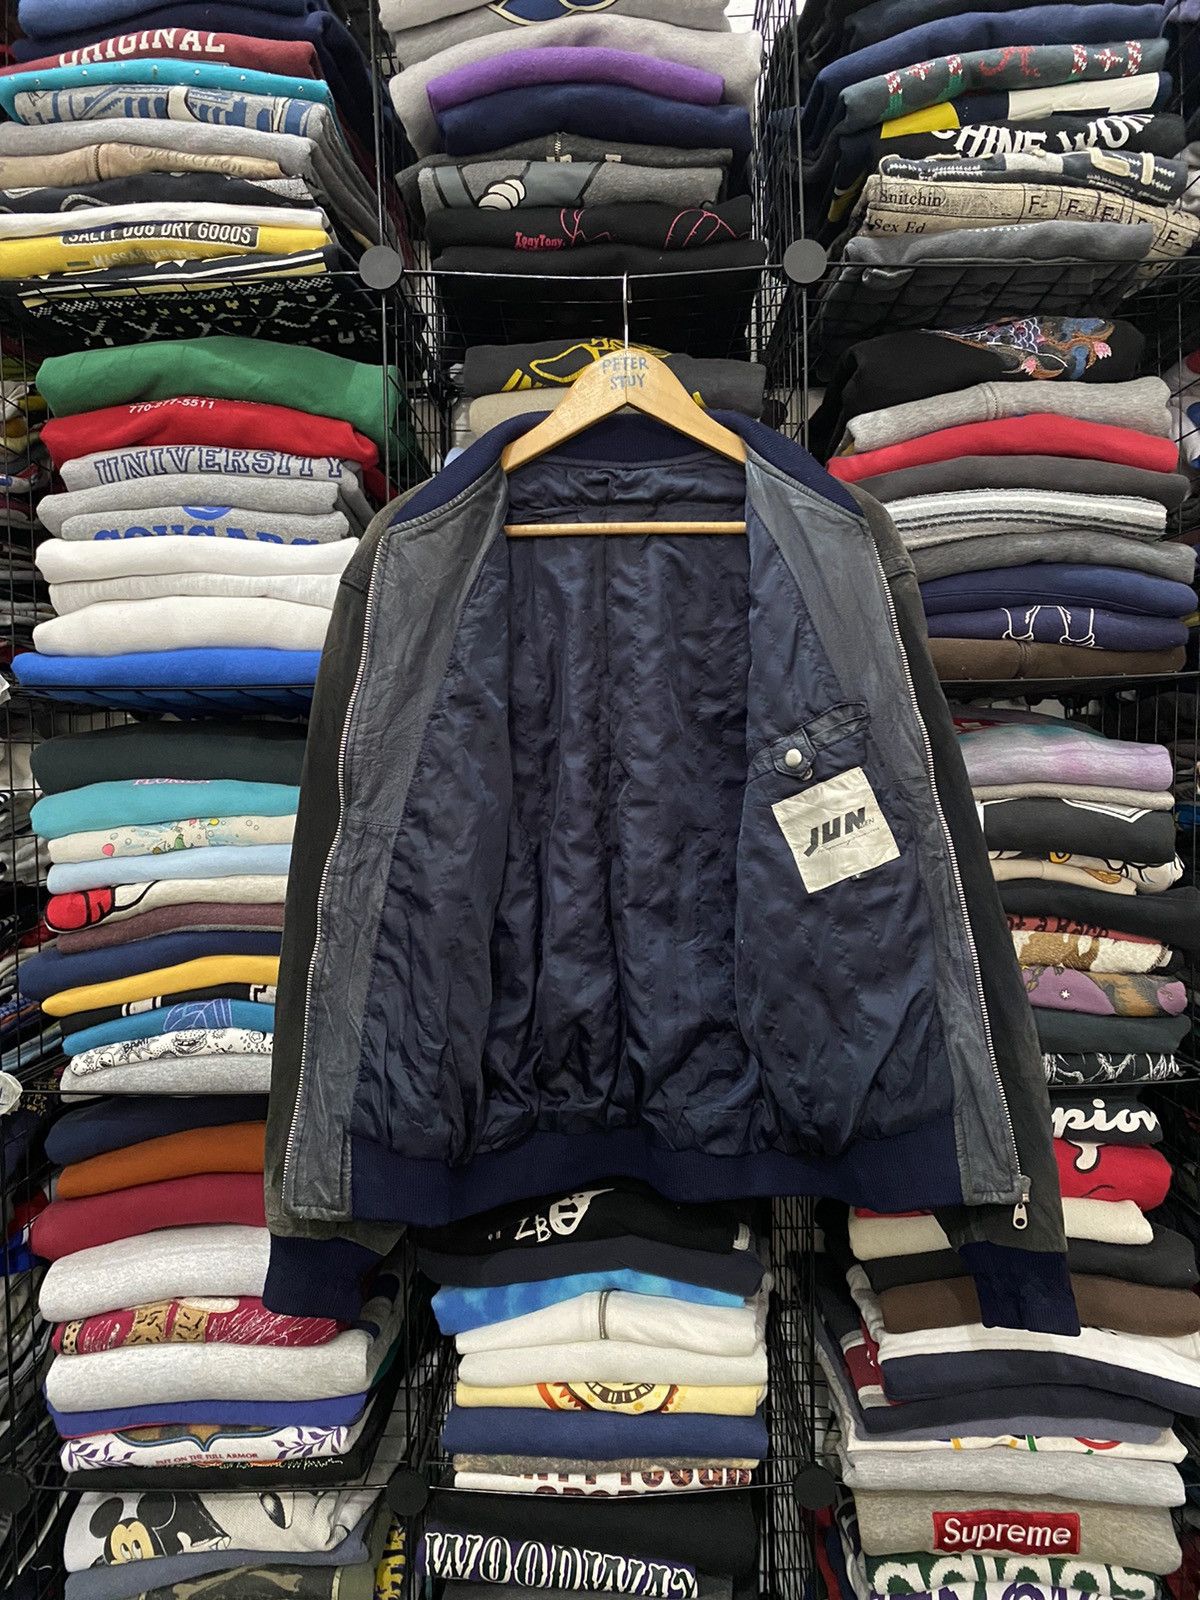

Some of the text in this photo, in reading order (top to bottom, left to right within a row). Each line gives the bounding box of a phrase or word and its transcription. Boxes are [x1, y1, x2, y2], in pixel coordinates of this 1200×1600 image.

[197, 222, 252, 245] GOODS
[873, 218, 927, 234] Sex Ed
[601, 356, 650, 375] PETER
[610, 373, 646, 390] STUY
[94, 445, 344, 485] UNIVERSITY
[803, 806, 866, 858] JUN
[226, 1452, 259, 1460] ARMOR
[943, 1517, 1072, 1548] Supreme
